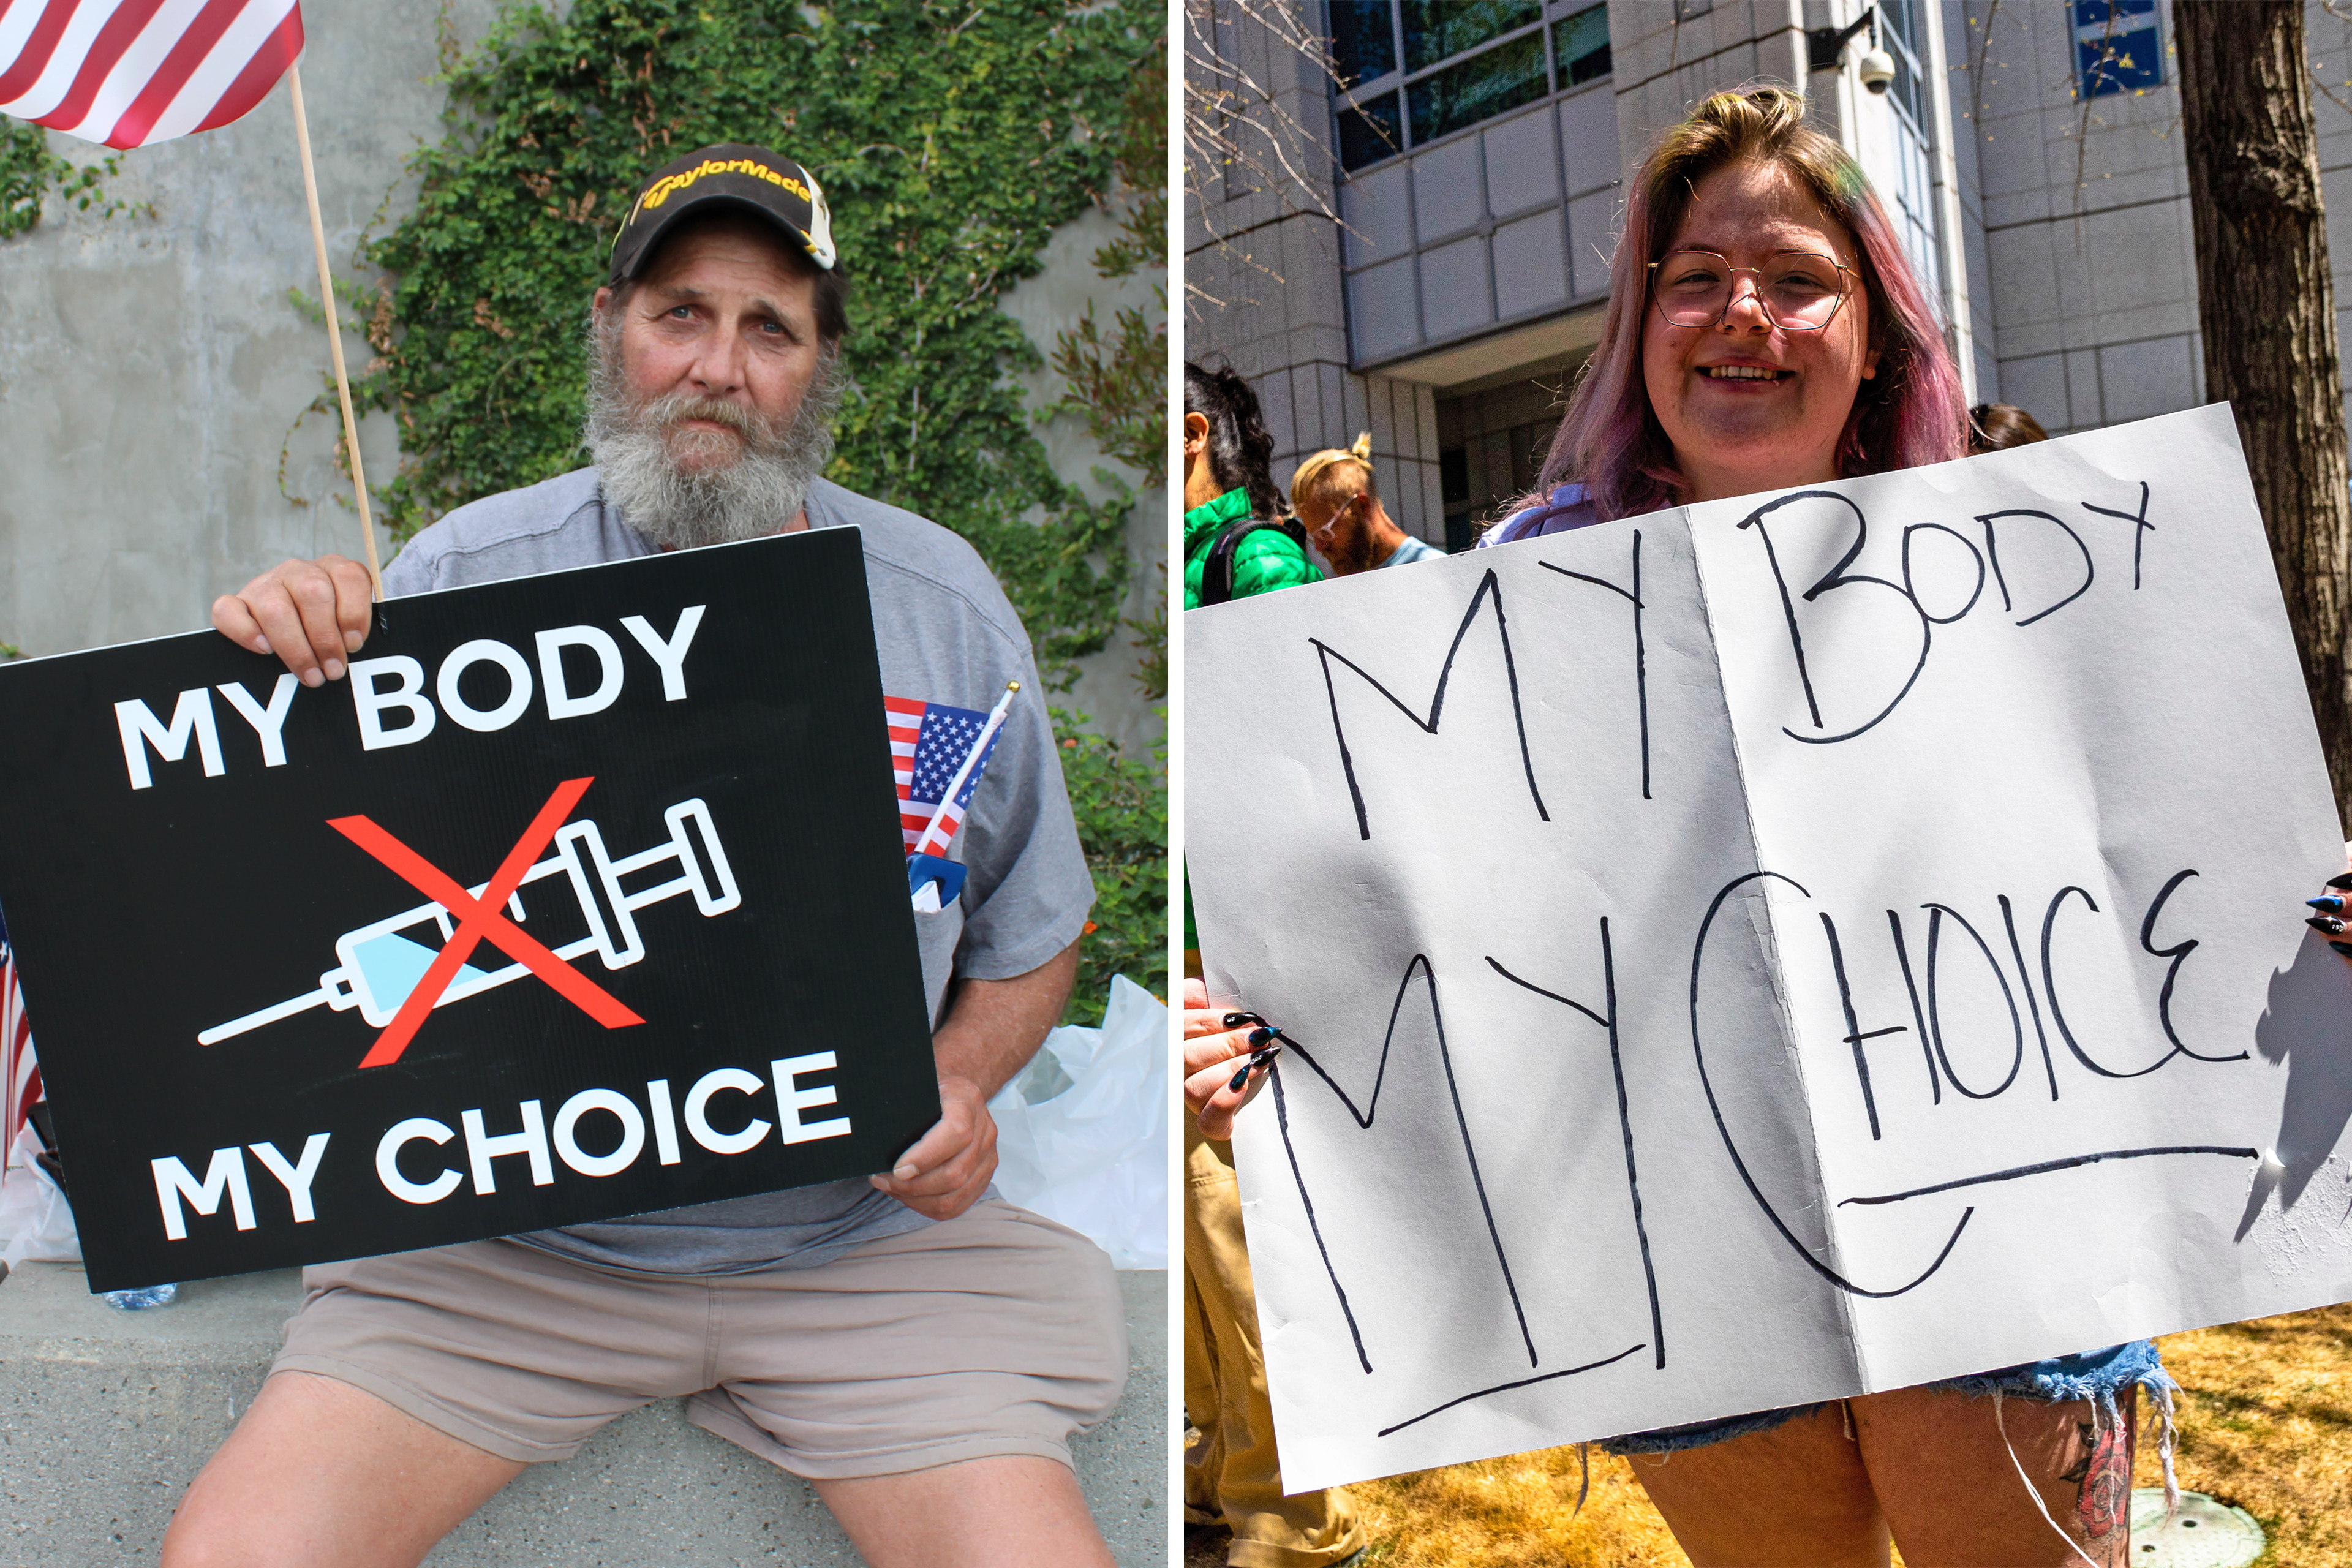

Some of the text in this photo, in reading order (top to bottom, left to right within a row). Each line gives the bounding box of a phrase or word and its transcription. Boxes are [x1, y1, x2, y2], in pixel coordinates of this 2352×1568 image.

[643, 159, 811, 210] TaylorMade
[114, 605, 707, 790] MY BODY
[1308, 481, 2156, 842] MY BODY
[151, 1050, 852, 1241] MY CHOICE
[1248, 869, 2252, 1374] MY CHOICE
